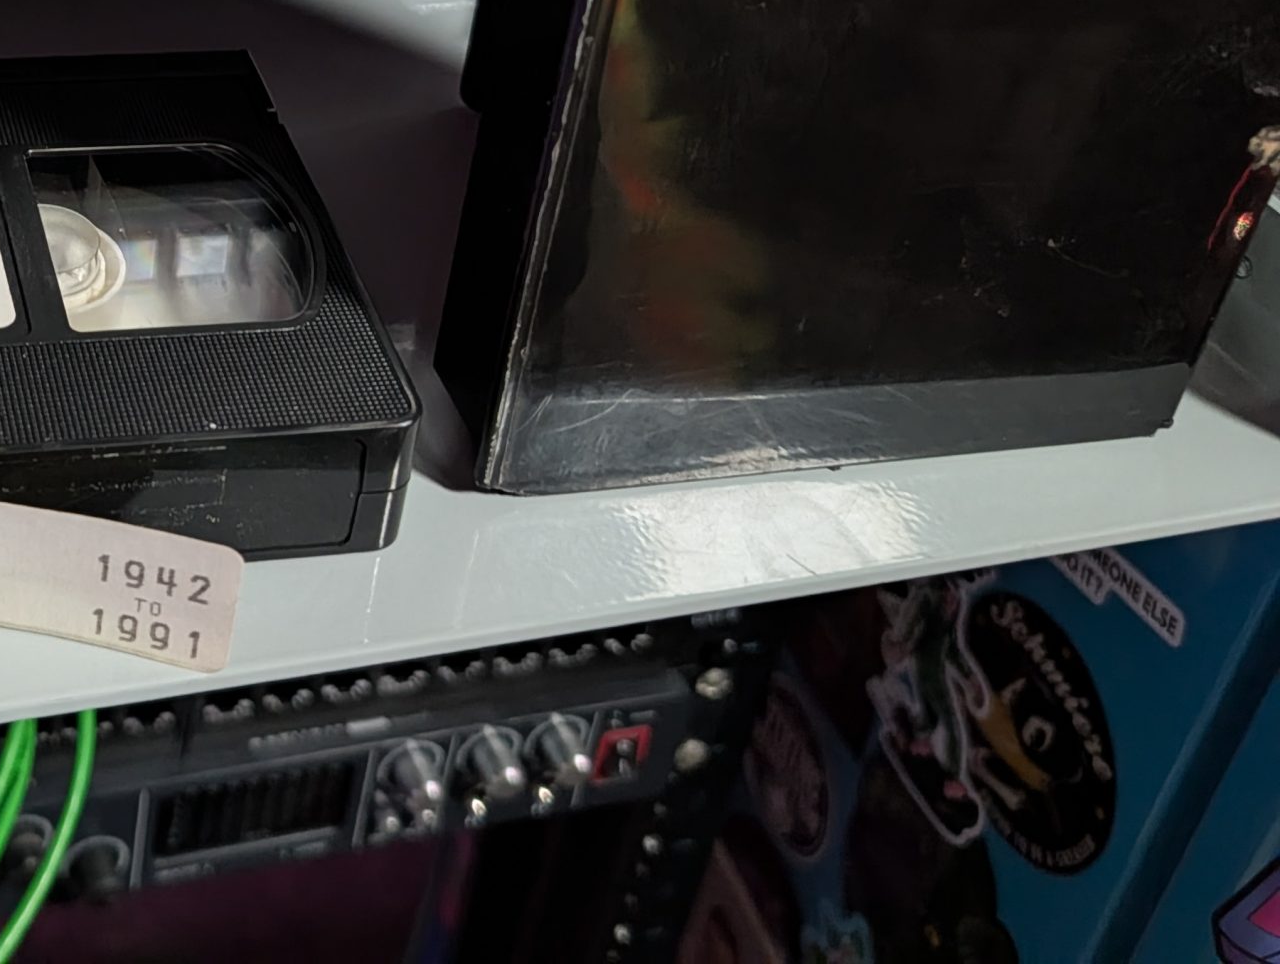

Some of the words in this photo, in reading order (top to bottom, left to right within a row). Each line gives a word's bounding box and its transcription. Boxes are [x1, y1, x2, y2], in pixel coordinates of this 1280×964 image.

[97, 553, 212, 606] 1942
[1089, 550, 1143, 603] MEONE
[1142, 591, 1179, 636] ELSE
[91, 607, 202, 659] 1991
[134, 597, 162, 618] TO
